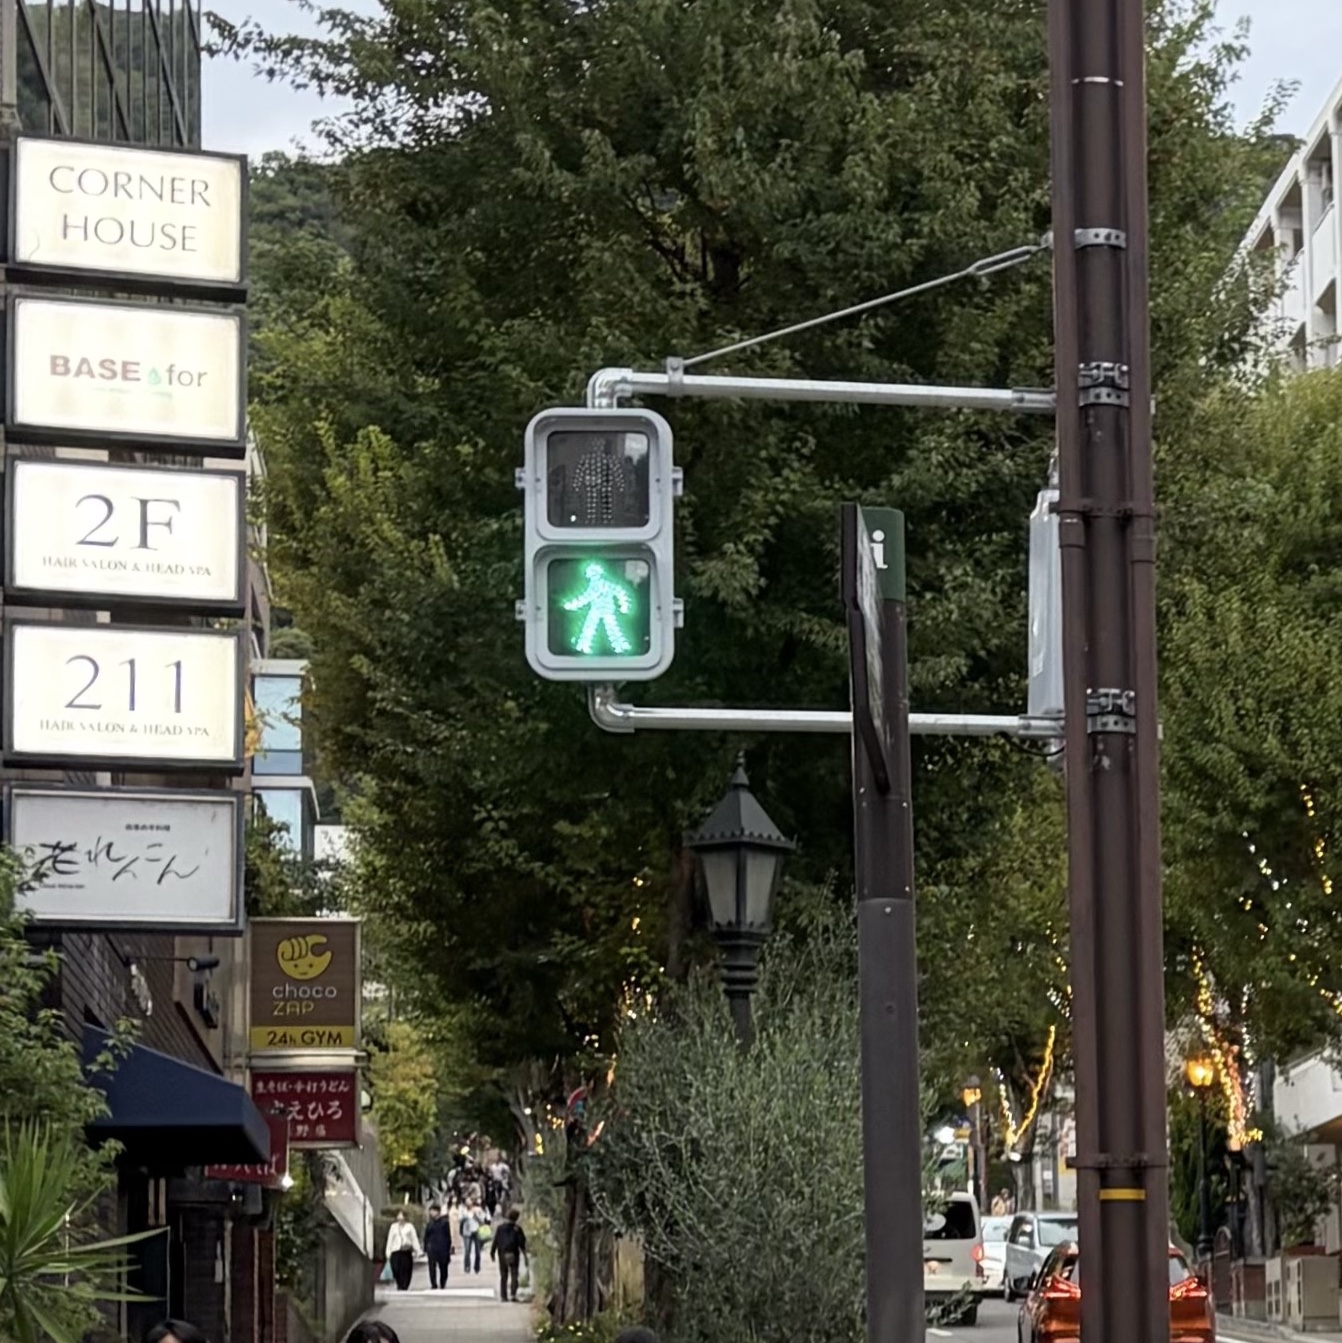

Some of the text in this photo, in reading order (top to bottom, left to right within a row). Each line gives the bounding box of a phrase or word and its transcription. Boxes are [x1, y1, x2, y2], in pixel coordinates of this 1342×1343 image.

[49, 165, 212, 207] CORNER
[62, 213, 198, 253] HOUSE
[49, 354, 208, 388] BASE for
[74, 493, 182, 551] 2F
[42, 555, 78, 569] HAIR
[81, 558, 128, 572] SALON
[145, 562, 185, 575] HEAD
[64, 654, 183, 714] 211
[39, 718, 75, 732] HAIR
[79, 721, 126, 734] SALON
[143, 723, 183, 736] HEAD
[272, 982, 337, 999] choco
[273, 1001, 315, 1016] ZAP
[267, 1030, 343, 1046] 24h GYM
